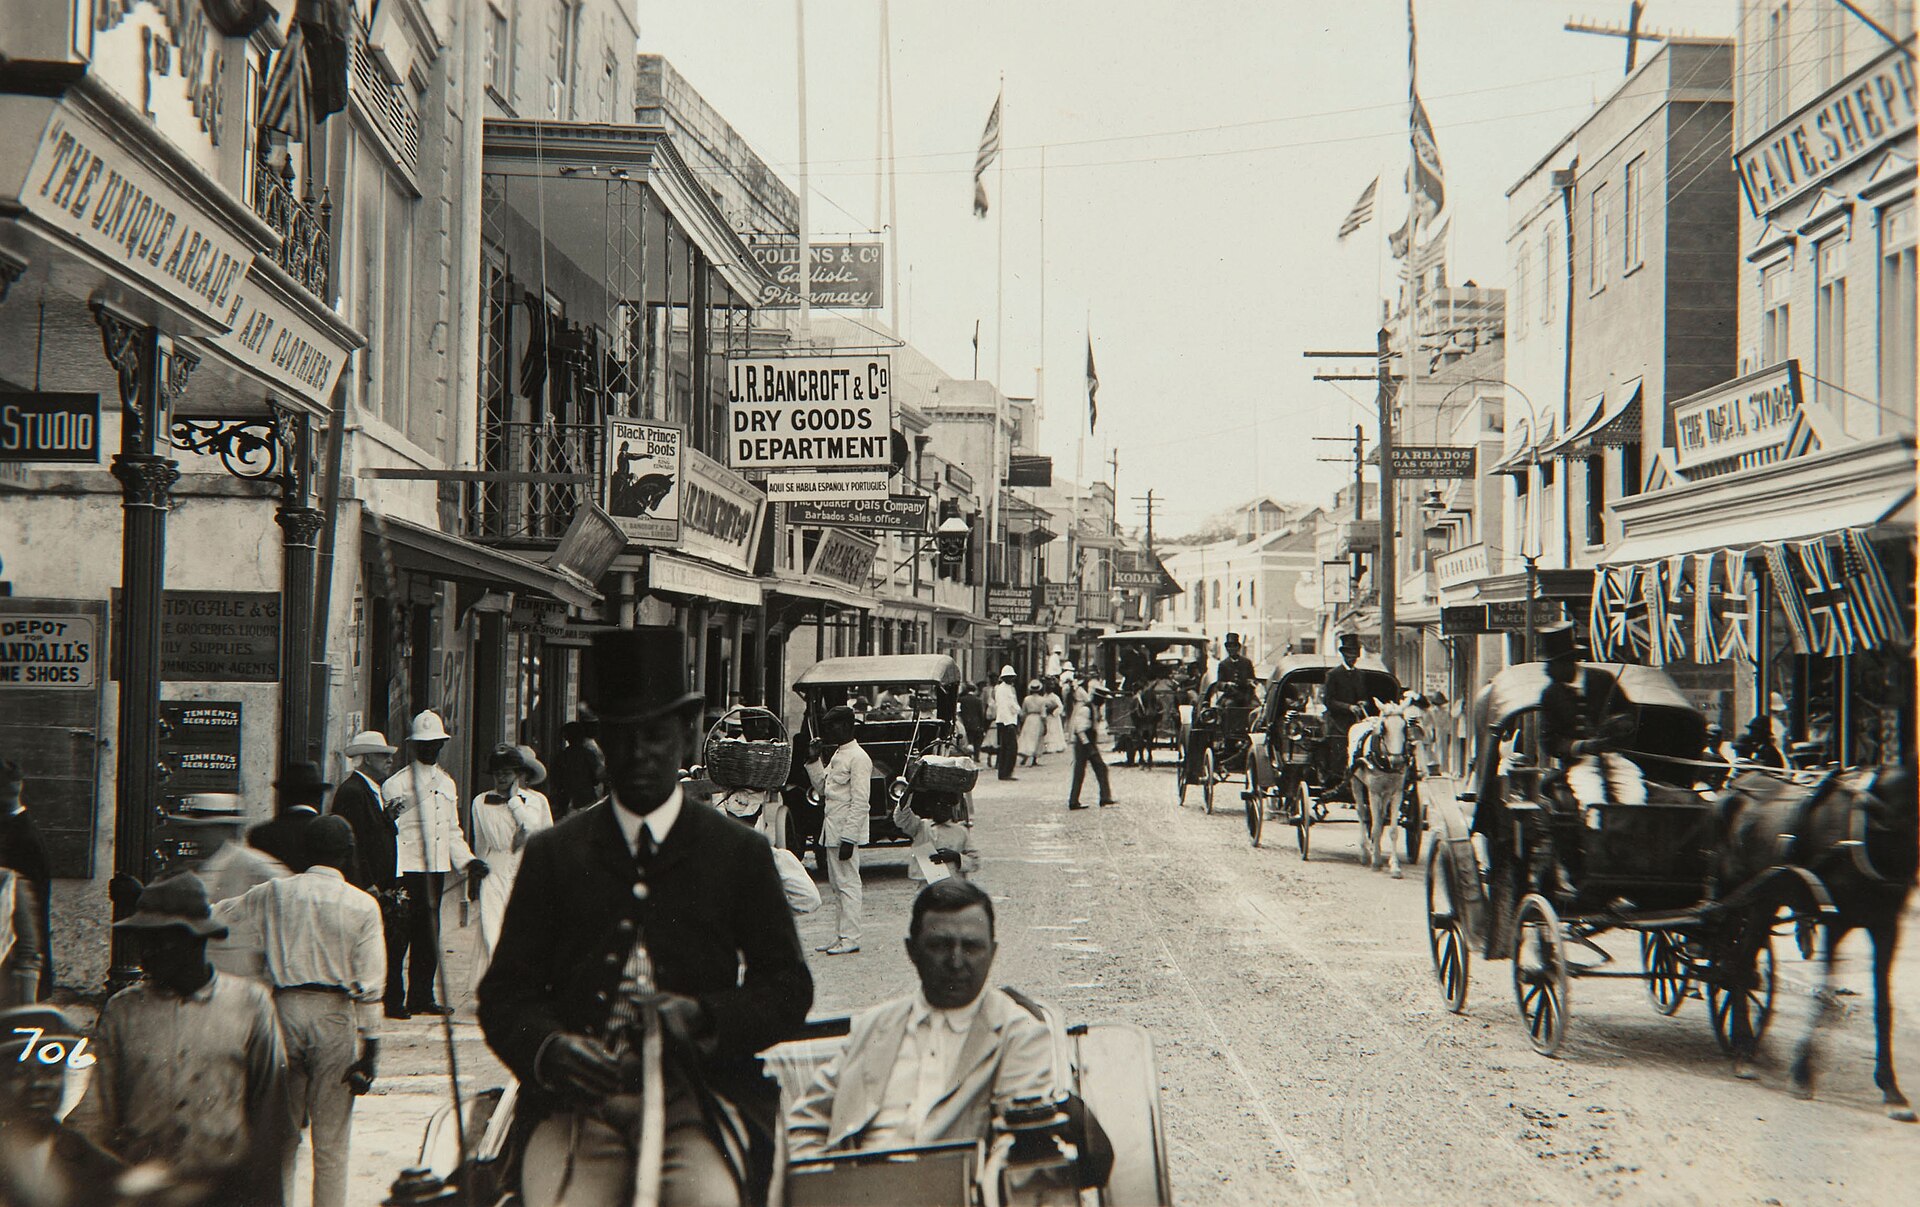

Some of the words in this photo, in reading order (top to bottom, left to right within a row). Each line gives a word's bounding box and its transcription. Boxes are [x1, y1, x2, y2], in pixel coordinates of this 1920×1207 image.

[91, 168, 176, 268] UNIQUE
[754, 248, 834, 264] COLLNS
[840, 247, 854, 263] &
[777, 265, 859, 283] Calisle
[238, 307, 274, 355] ART
[271, 326, 333, 392] CLOTHIERS
[853, 376, 864, 400] &
[734, 410, 782, 432] DRY
[791, 408, 872, 430] GOODS
[1679, 411, 1705, 451] THE
[1748, 383, 1794, 432] STORE
[647, 441, 676, 457] Boots
[739, 436, 888, 461] DEPARTMENT
[1391, 451, 1472, 460] BARBADOS
[1393, 460, 1417, 468] GAS
[786, 483, 795, 492] SE
[795, 482, 817, 492] HABLA
[845, 481, 850, 491] Y
[883, 500, 924, 515] Company
[804, 511, 845, 521] Barbados
[848, 513, 871, 523] Sales
[874, 515, 901, 525] Office
[1115, 572, 1162, 584] KODAK
[250, 602, 261, 618] &
[1492, 614, 1554, 624] WAREHUSE
[1, 620, 67, 637] DEPOT
[25, 665, 79, 682] SHOES
[211, 718, 239, 726] STOUT
[209, 762, 237, 770] STOUT
